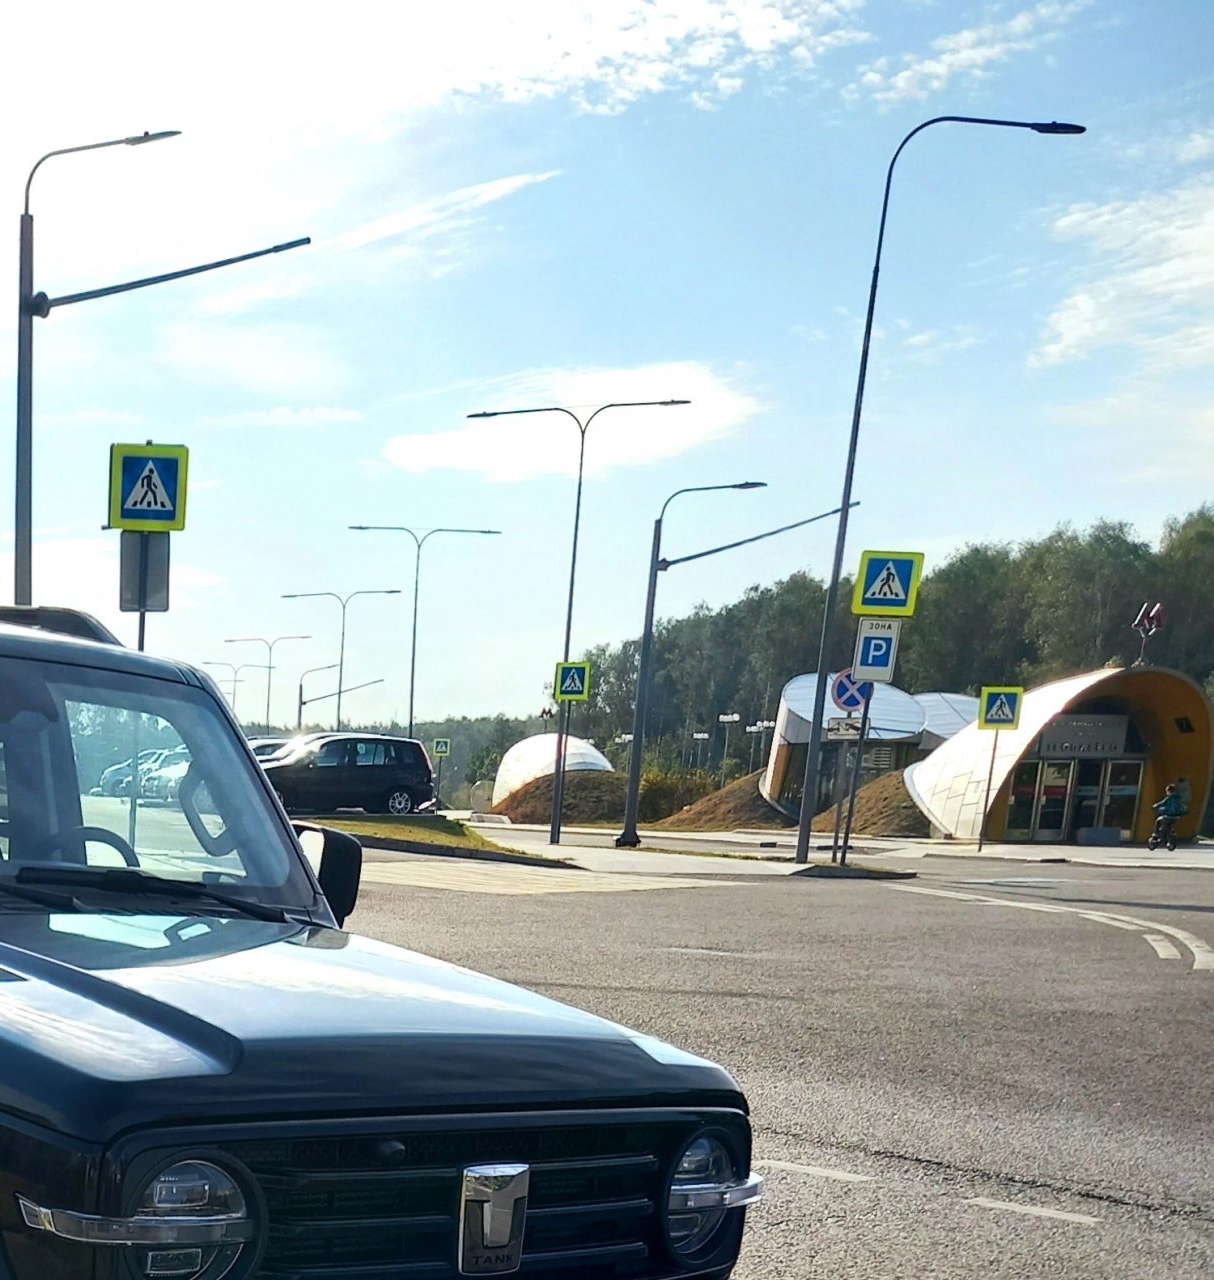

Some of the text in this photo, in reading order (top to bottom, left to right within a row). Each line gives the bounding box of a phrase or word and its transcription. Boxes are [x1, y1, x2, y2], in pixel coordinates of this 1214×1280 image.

[869, 622, 892, 631] ЗОНА
[867, 639, 887, 665] P
[472, 1254, 514, 1266] TANK
